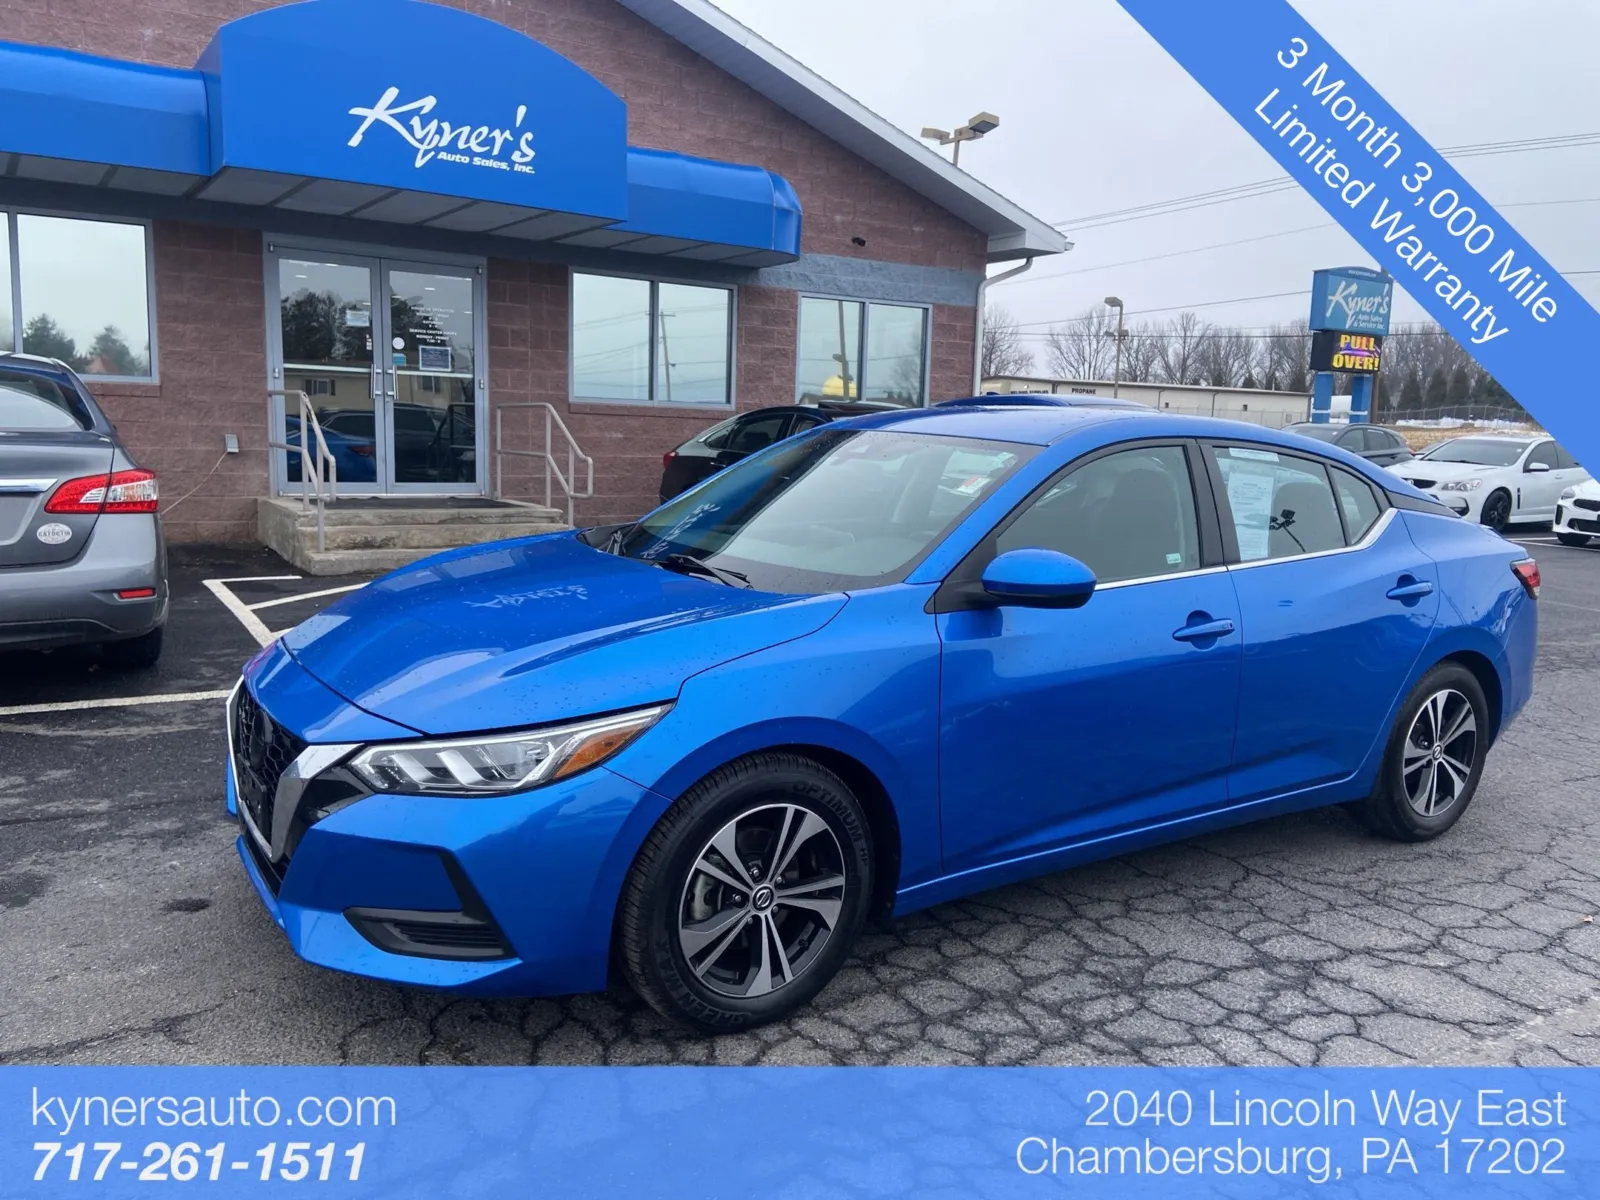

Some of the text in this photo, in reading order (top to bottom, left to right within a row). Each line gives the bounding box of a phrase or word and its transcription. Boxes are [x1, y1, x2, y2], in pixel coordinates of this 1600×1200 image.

[347, 86, 536, 168] Kyner's
[437, 151, 536, 174] Auto Sales, Inc.
[1326, 280, 1390, 329] Kyner's
[1359, 321, 1376, 329] Service
[1340, 334, 1376, 351] PULL
[1332, 354, 1380, 371] OVER!
